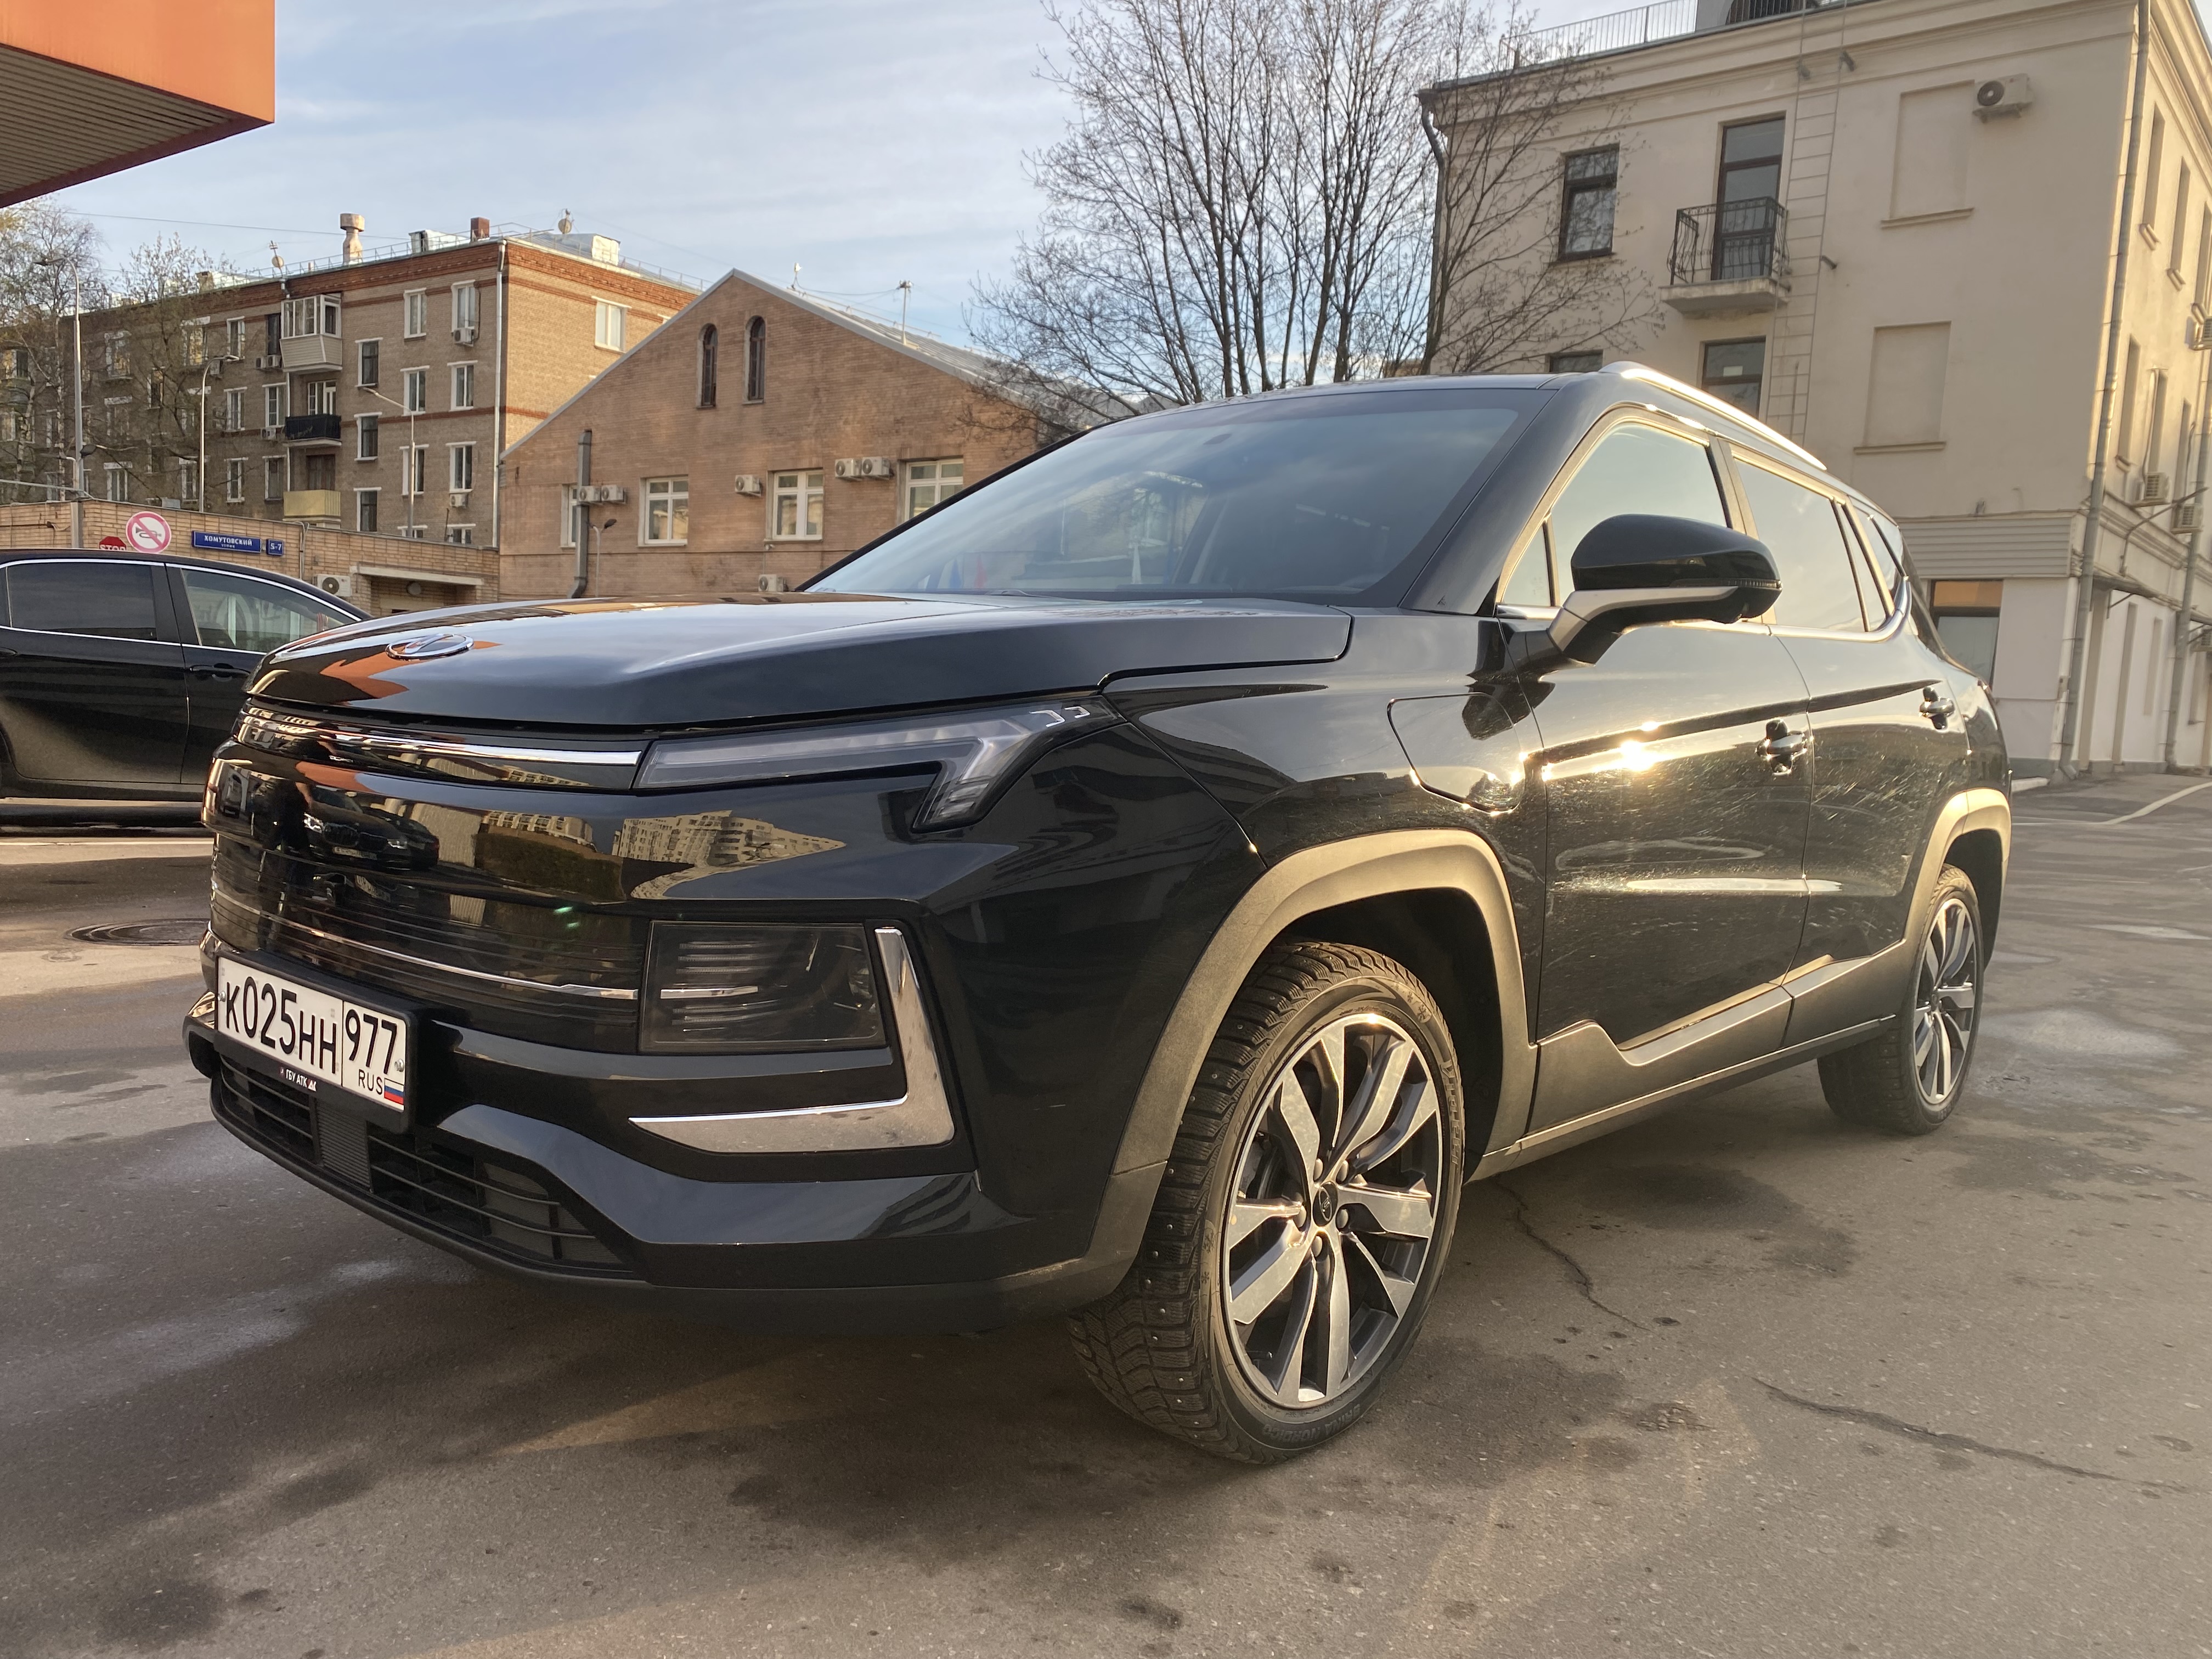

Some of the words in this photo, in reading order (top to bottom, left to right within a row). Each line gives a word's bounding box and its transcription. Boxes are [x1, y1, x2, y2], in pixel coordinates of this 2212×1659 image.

[205, 535, 252, 546] ХОМУТОВСКИЙ
[345, 1009, 397, 1074] 977
[286, 1069, 296, 1082] ГБУ
[296, 1074, 307, 1088] АТК
[358, 1069, 383, 1094] RUS
